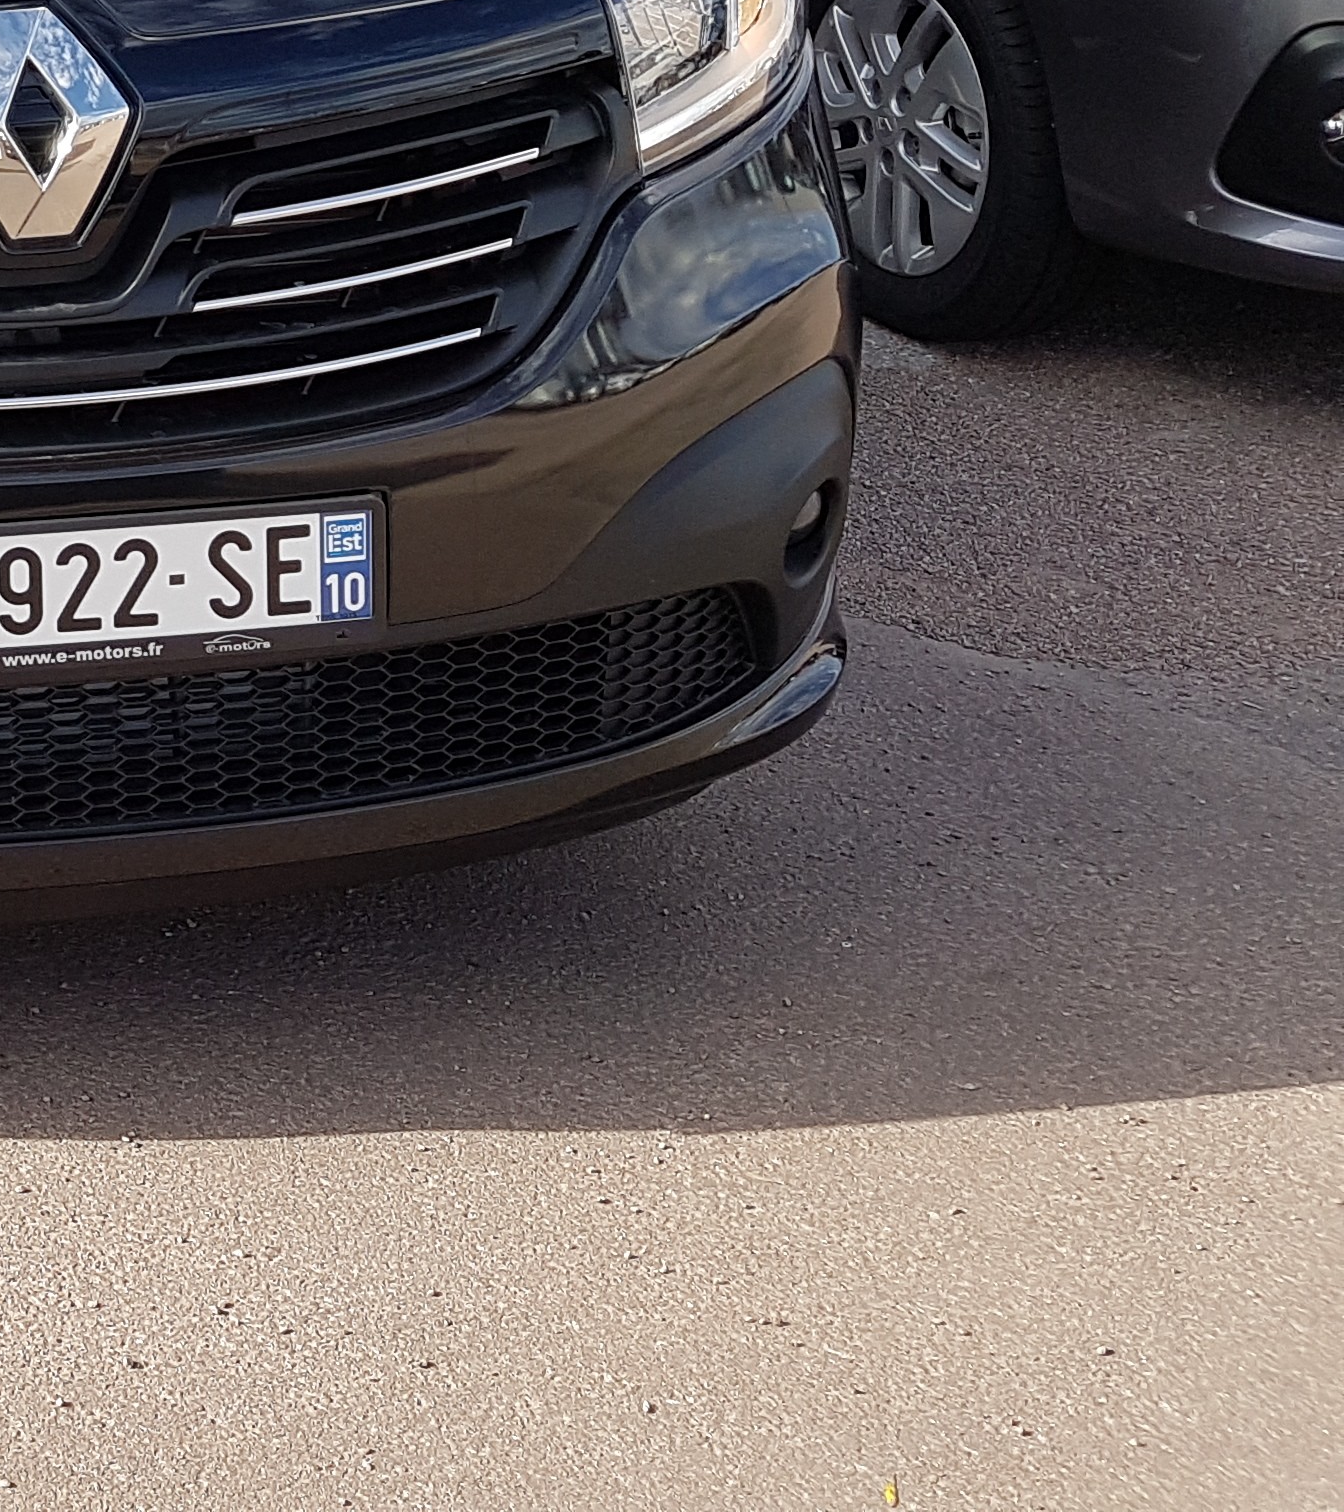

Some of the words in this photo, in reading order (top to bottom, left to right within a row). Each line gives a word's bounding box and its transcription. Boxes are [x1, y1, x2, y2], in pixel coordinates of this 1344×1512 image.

[328, 521, 363, 533] Grand
[328, 533, 363, 553] Est
[325, 572, 366, 614] 10
[2, 642, 164, 668] www.e-motors.fr
